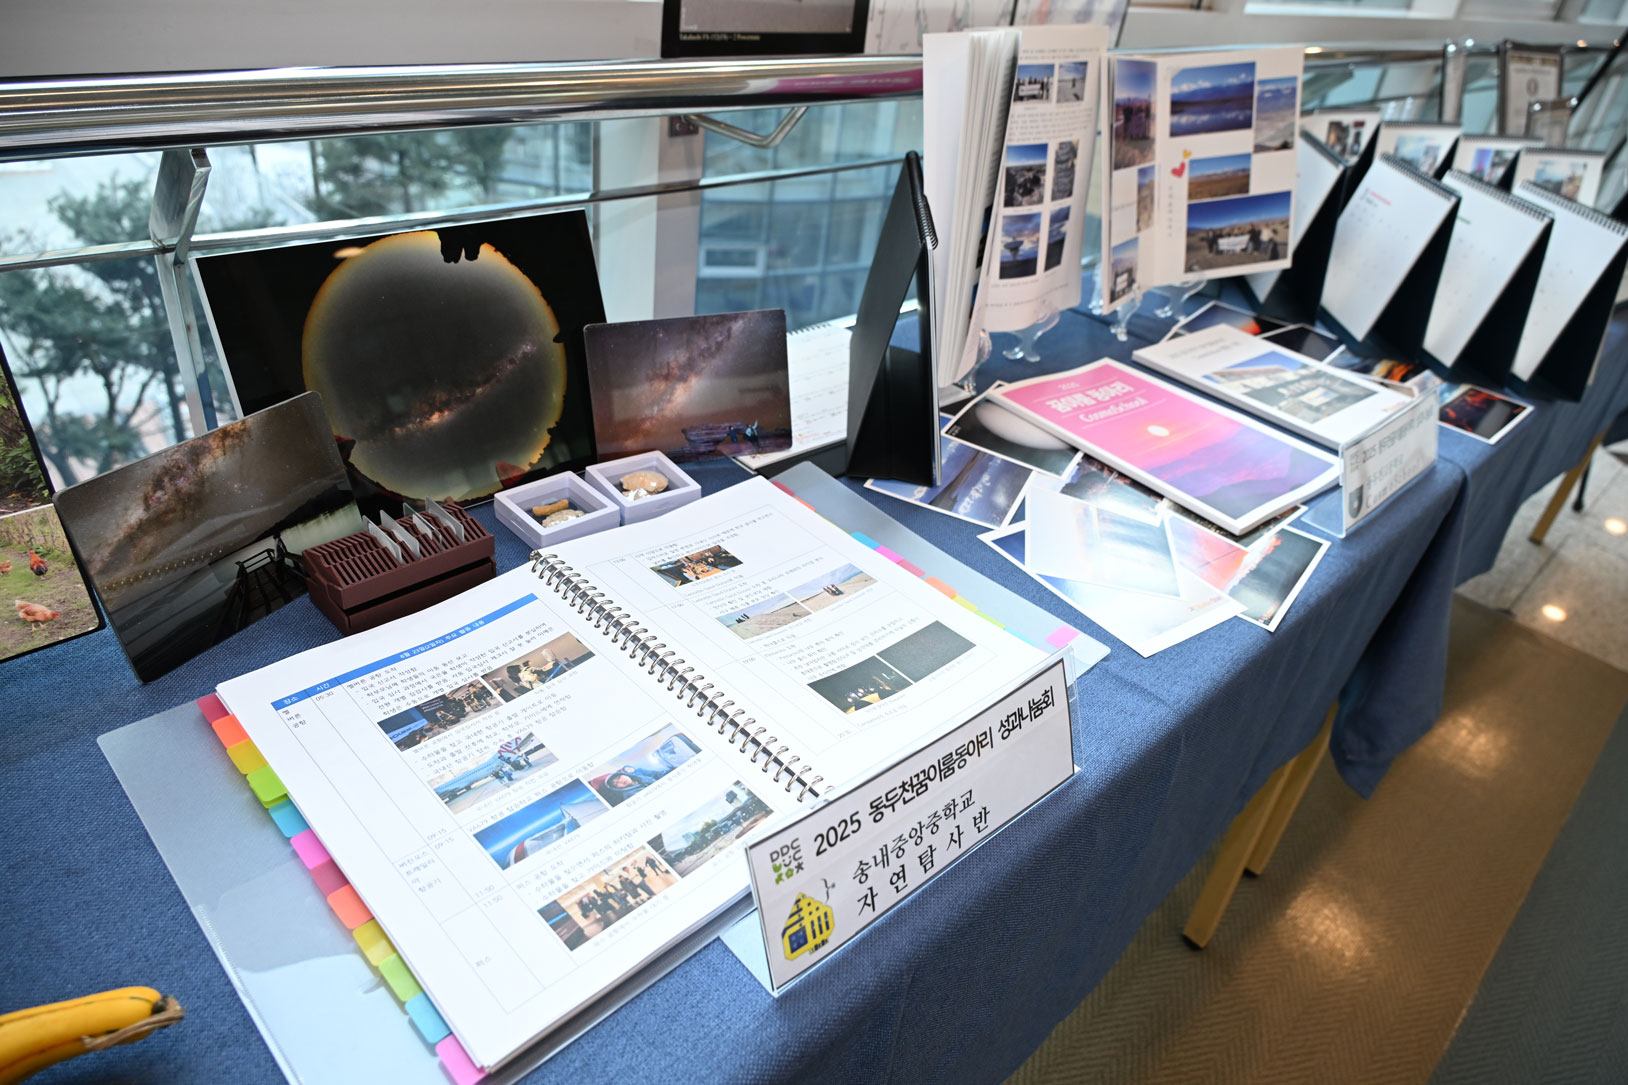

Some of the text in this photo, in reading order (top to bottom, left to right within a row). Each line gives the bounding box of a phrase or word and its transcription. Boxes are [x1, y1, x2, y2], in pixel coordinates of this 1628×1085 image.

[1085, 381, 1135, 402] 동아리
[368, 672, 382, 680] 공항
[376, 674, 397, 685] 신고서
[314, 682, 331, 691] 시간
[283, 695, 299, 704] 장소
[813, 810, 862, 857] 2025
[867, 727, 994, 825] 동두천꿈이룸동아리
[997, 685, 1056, 741] 성과나눔회
[852, 789, 976, 886] 송내중앙중학교
